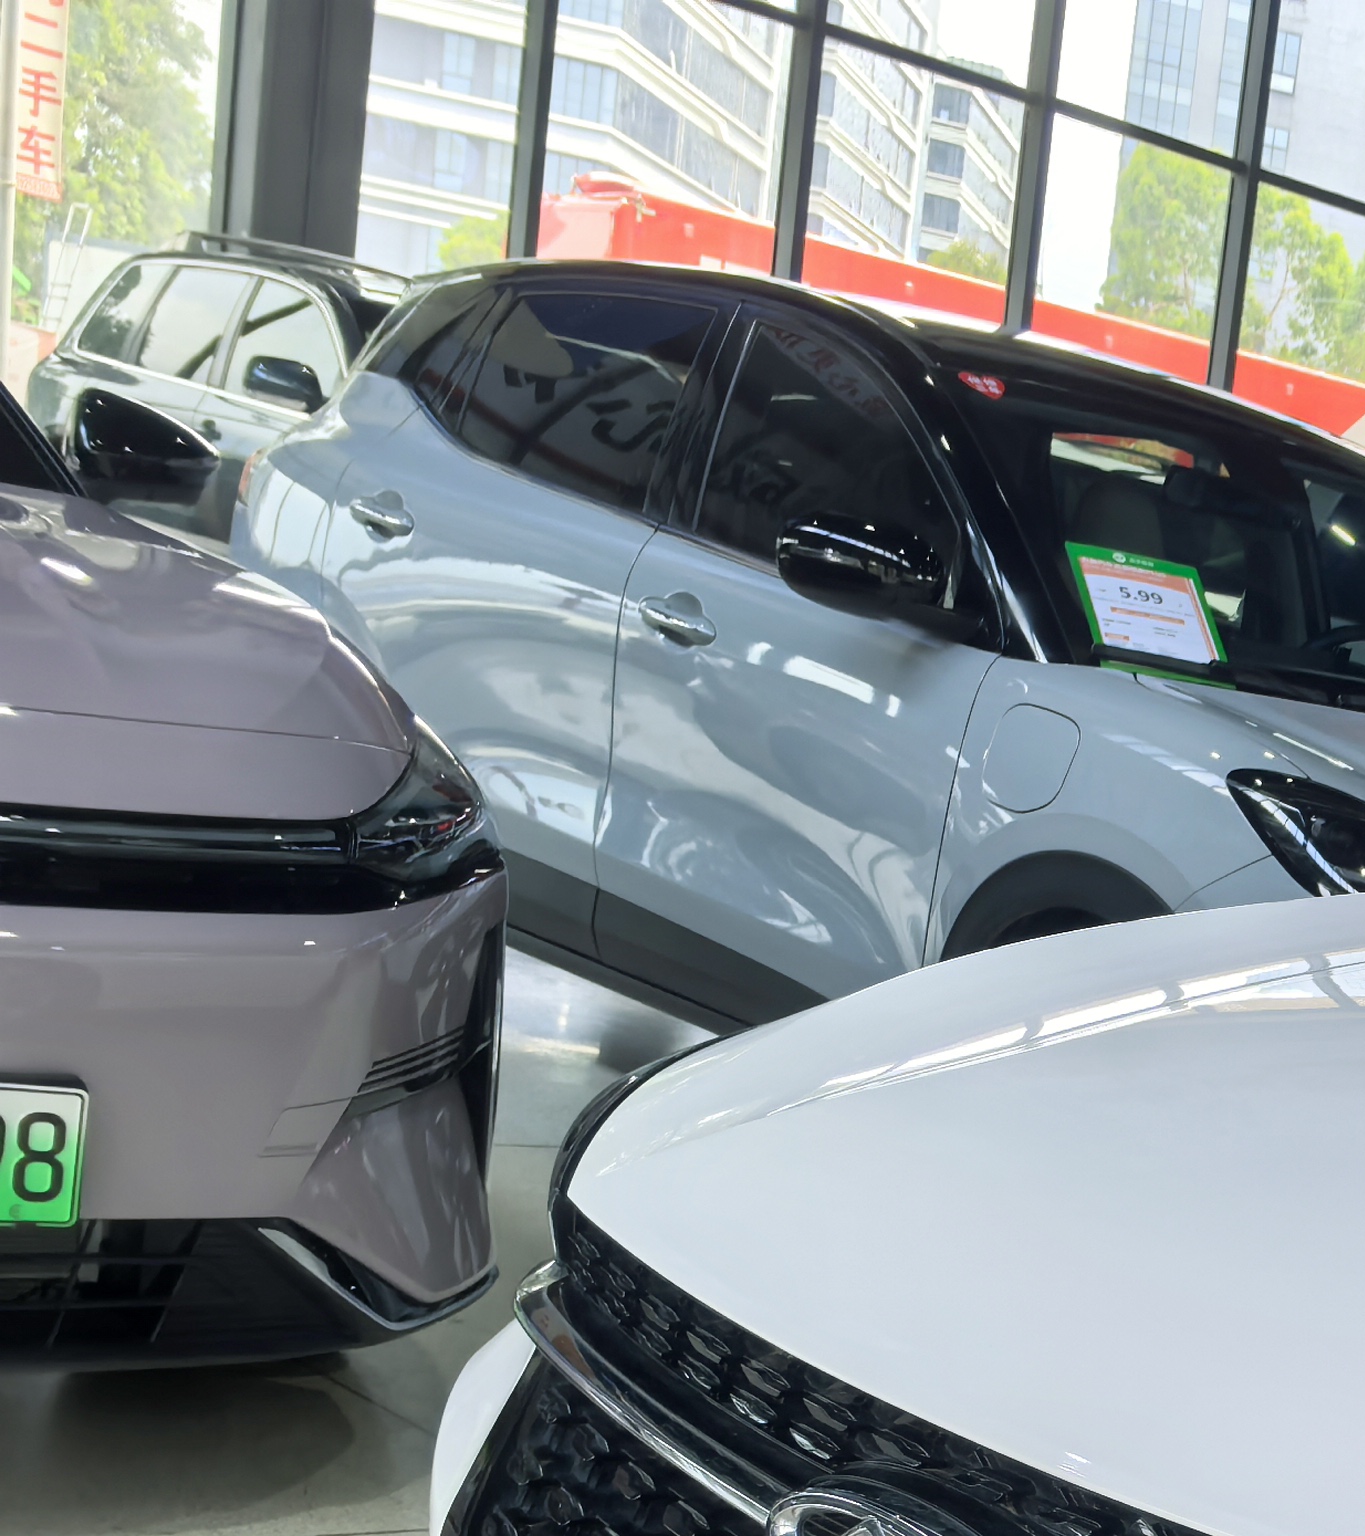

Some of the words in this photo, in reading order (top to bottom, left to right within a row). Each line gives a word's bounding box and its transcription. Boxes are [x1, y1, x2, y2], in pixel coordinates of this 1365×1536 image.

[16, 0, 64, 175] 二手车
[1118, 585, 1164, 605] 5.99
[0, 1111, 66, 1202] 8
